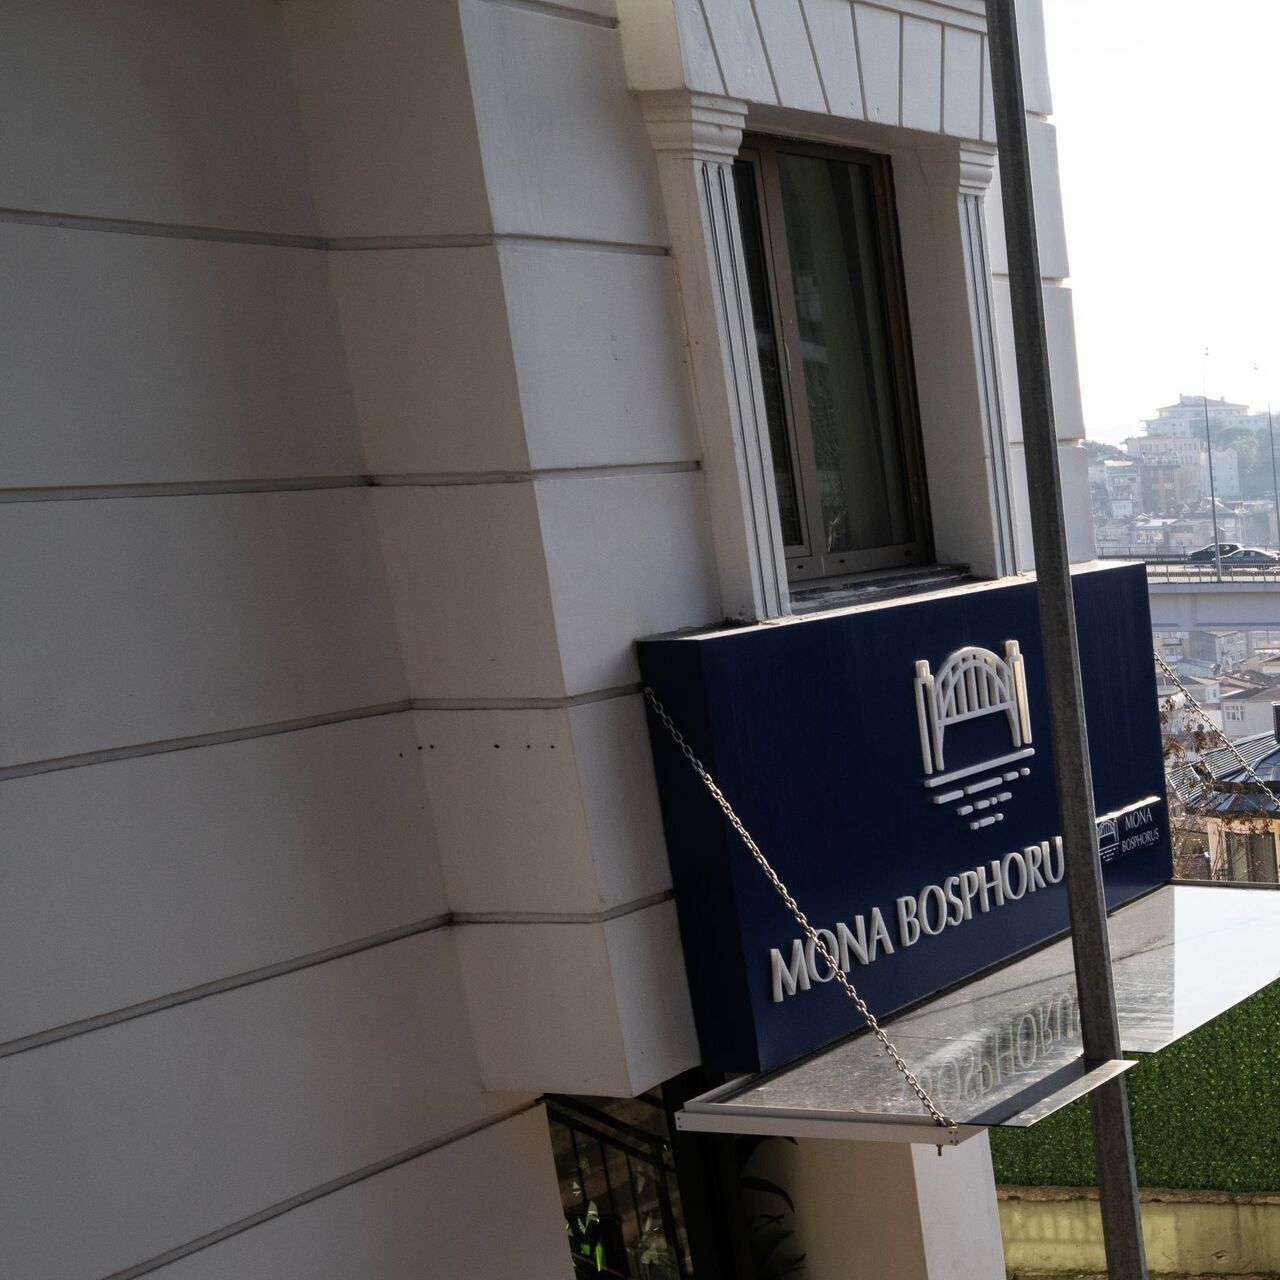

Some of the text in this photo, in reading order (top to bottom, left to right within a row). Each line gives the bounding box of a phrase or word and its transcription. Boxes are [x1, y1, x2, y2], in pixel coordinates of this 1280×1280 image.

[1124, 807, 1153, 831] MONA
[1121, 827, 1160, 852] BOSPHORUS
[770, 835, 1065, 1003] MONA BOSPHORU
